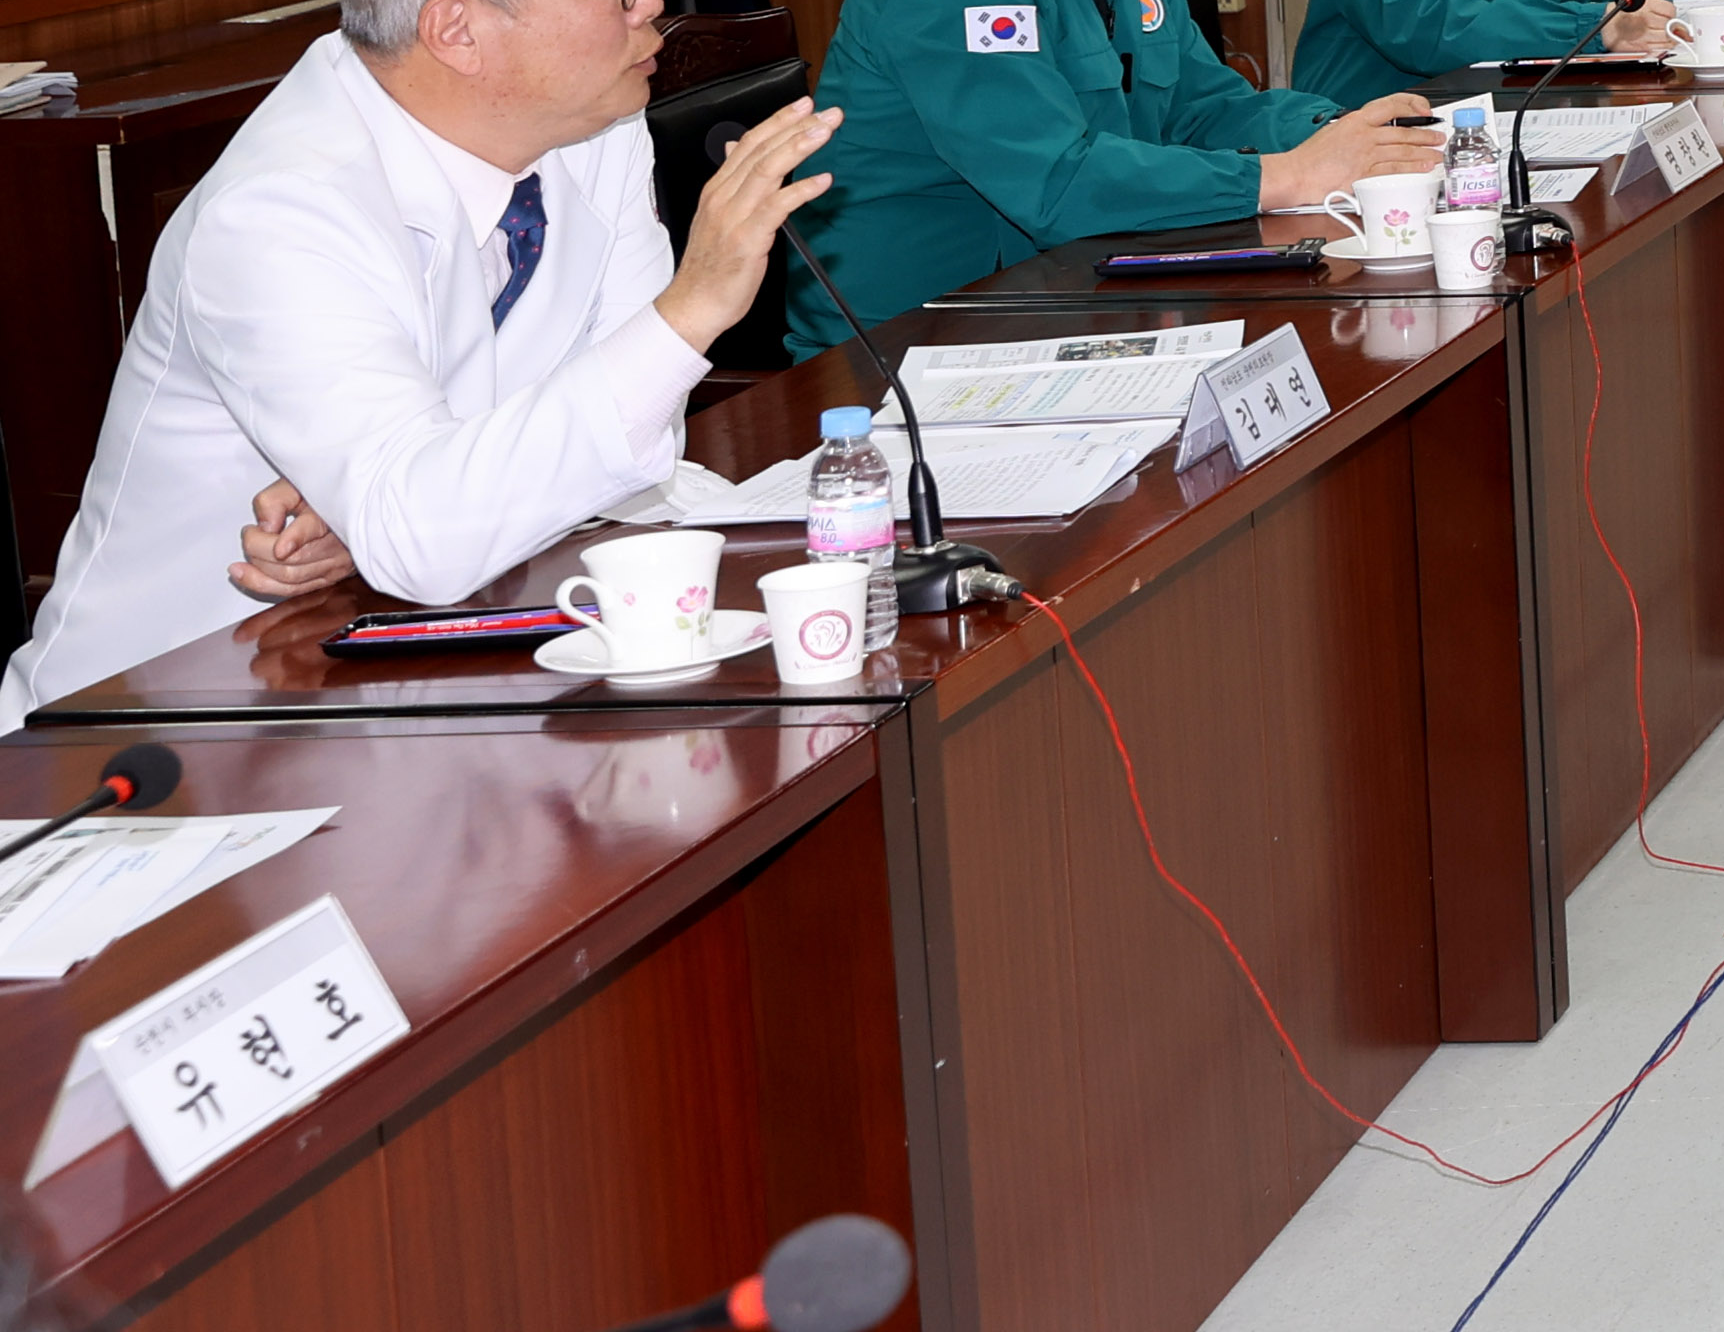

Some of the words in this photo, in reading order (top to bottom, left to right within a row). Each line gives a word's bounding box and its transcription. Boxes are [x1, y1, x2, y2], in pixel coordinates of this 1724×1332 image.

[1462, 180, 1485, 191] ICIS
[1234, 366, 1313, 442] 김대연
[172, 976, 366, 1132] 유현호
